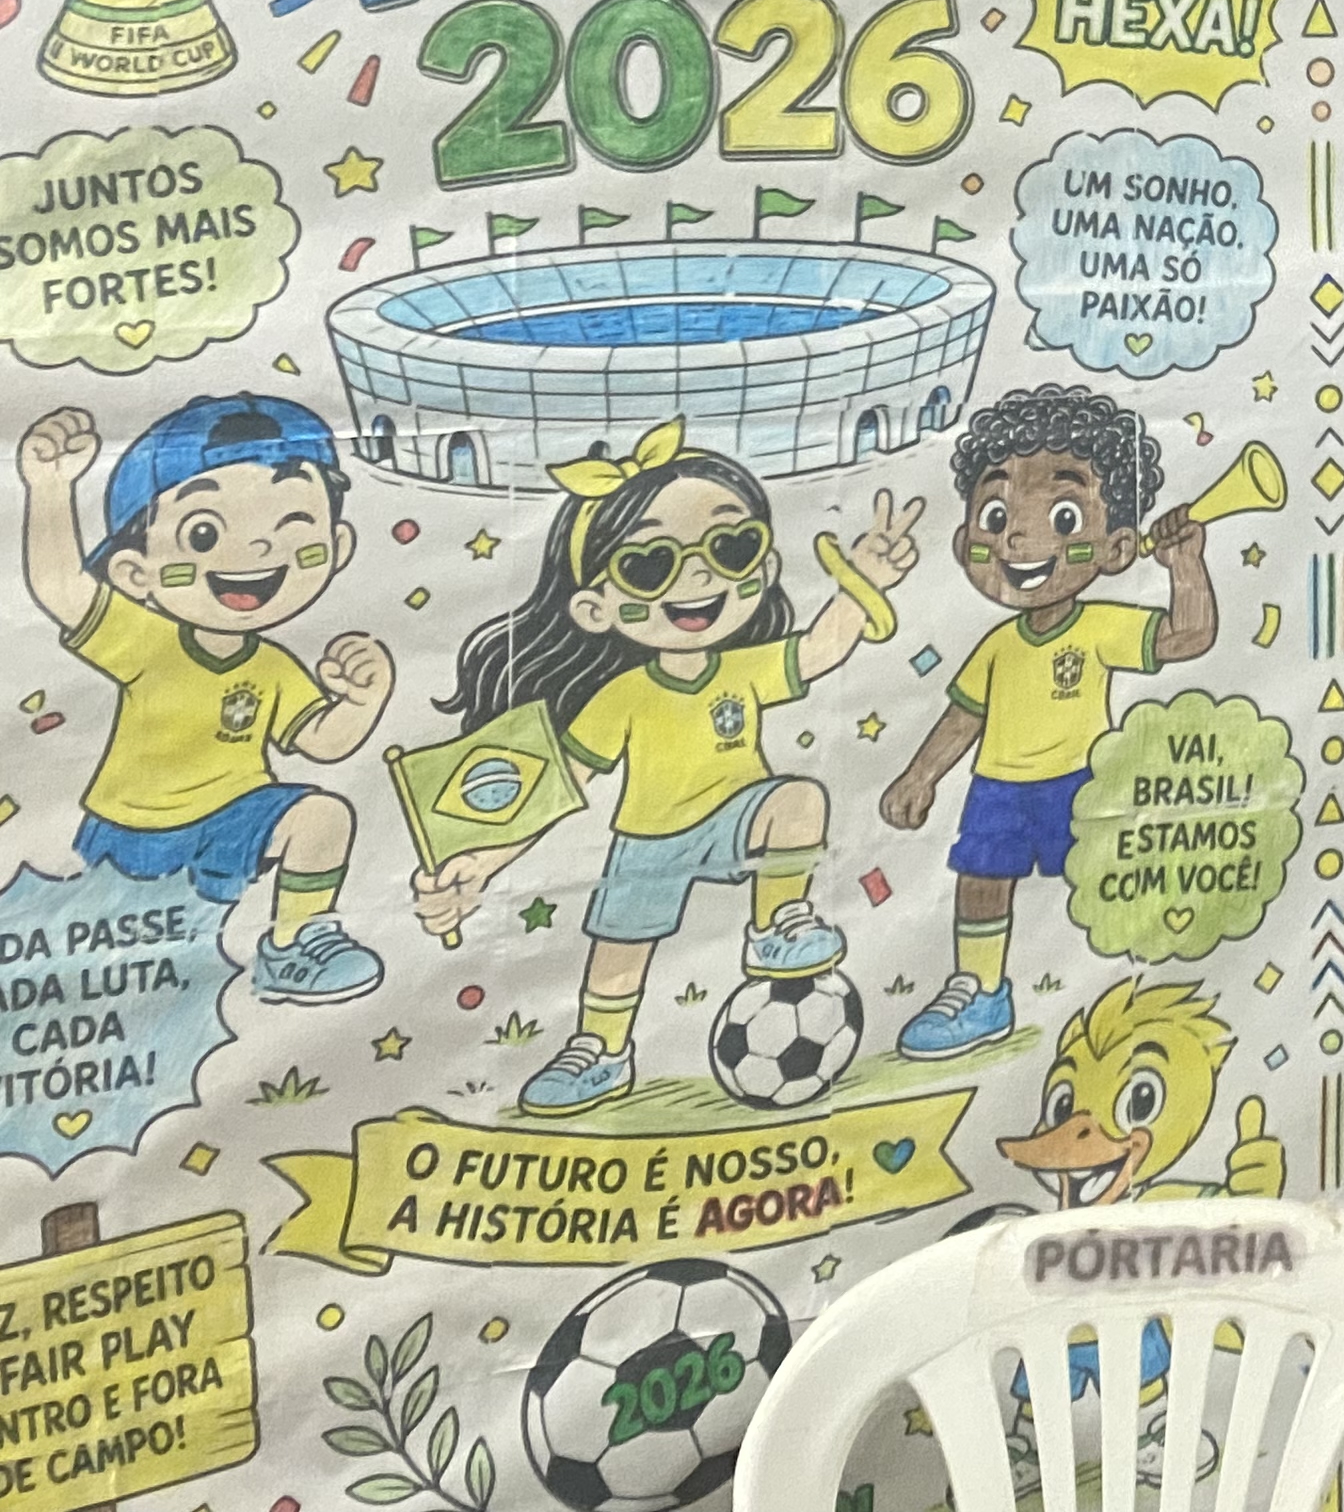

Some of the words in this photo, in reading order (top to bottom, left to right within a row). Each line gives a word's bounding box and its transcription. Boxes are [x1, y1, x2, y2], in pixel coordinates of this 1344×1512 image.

[70, 47, 163, 73] WORLD
[173, 40, 215, 68] CUP
[110, 25, 170, 44] FIFA
[32, 161, 204, 215] JUNTOS
[1064, 169, 1112, 200] UM
[0, 219, 139, 270] SOMOS
[155, 202, 258, 256] MAIS
[1052, 208, 1121, 240] UMA
[42, 256, 219, 314] FORTES!
[1080, 250, 1150, 281] UMA
[1161, 250, 1202, 283] SÓ
[1080, 288, 1207, 324] PAIXÃO!
[1167, 733, 1224, 767] VAI,
[1133, 773, 1254, 808] BRASIL!
[1117, 820, 1257, 861] ESTAMOS
[1099, 865, 1166, 902] COM
[1177, 854, 1263, 895] VOCÊ!
[66, 904, 199, 956] PASSE,
[12, 1010, 125, 1057] CADA
[0, 1050, 156, 1108] ITÓRIA!
[405, 1142, 439, 1181] O
[453, 1149, 628, 1194] FUTURO
[644, 1146, 668, 1192] É
[684, 1134, 841, 1186] NOSSO,
[387, 1194, 419, 1234] A
[436, 1189, 640, 1245] HISTÓRIA
[656, 1203, 681, 1240] É
[694, 1169, 855, 1240] AGORA!
[1034, 1228, 1294, 1284] PORTARIA
[42, 1254, 216, 1332] RESPEITO
[0, 1339, 87, 1397] FAIR
[100, 1308, 196, 1372] PLAY
[103, 1383, 122, 1421] E
[131, 1356, 224, 1414] FORA
[602, 1333, 744, 1445] 2026
[47, 1414, 187, 1485] CAMPO!
